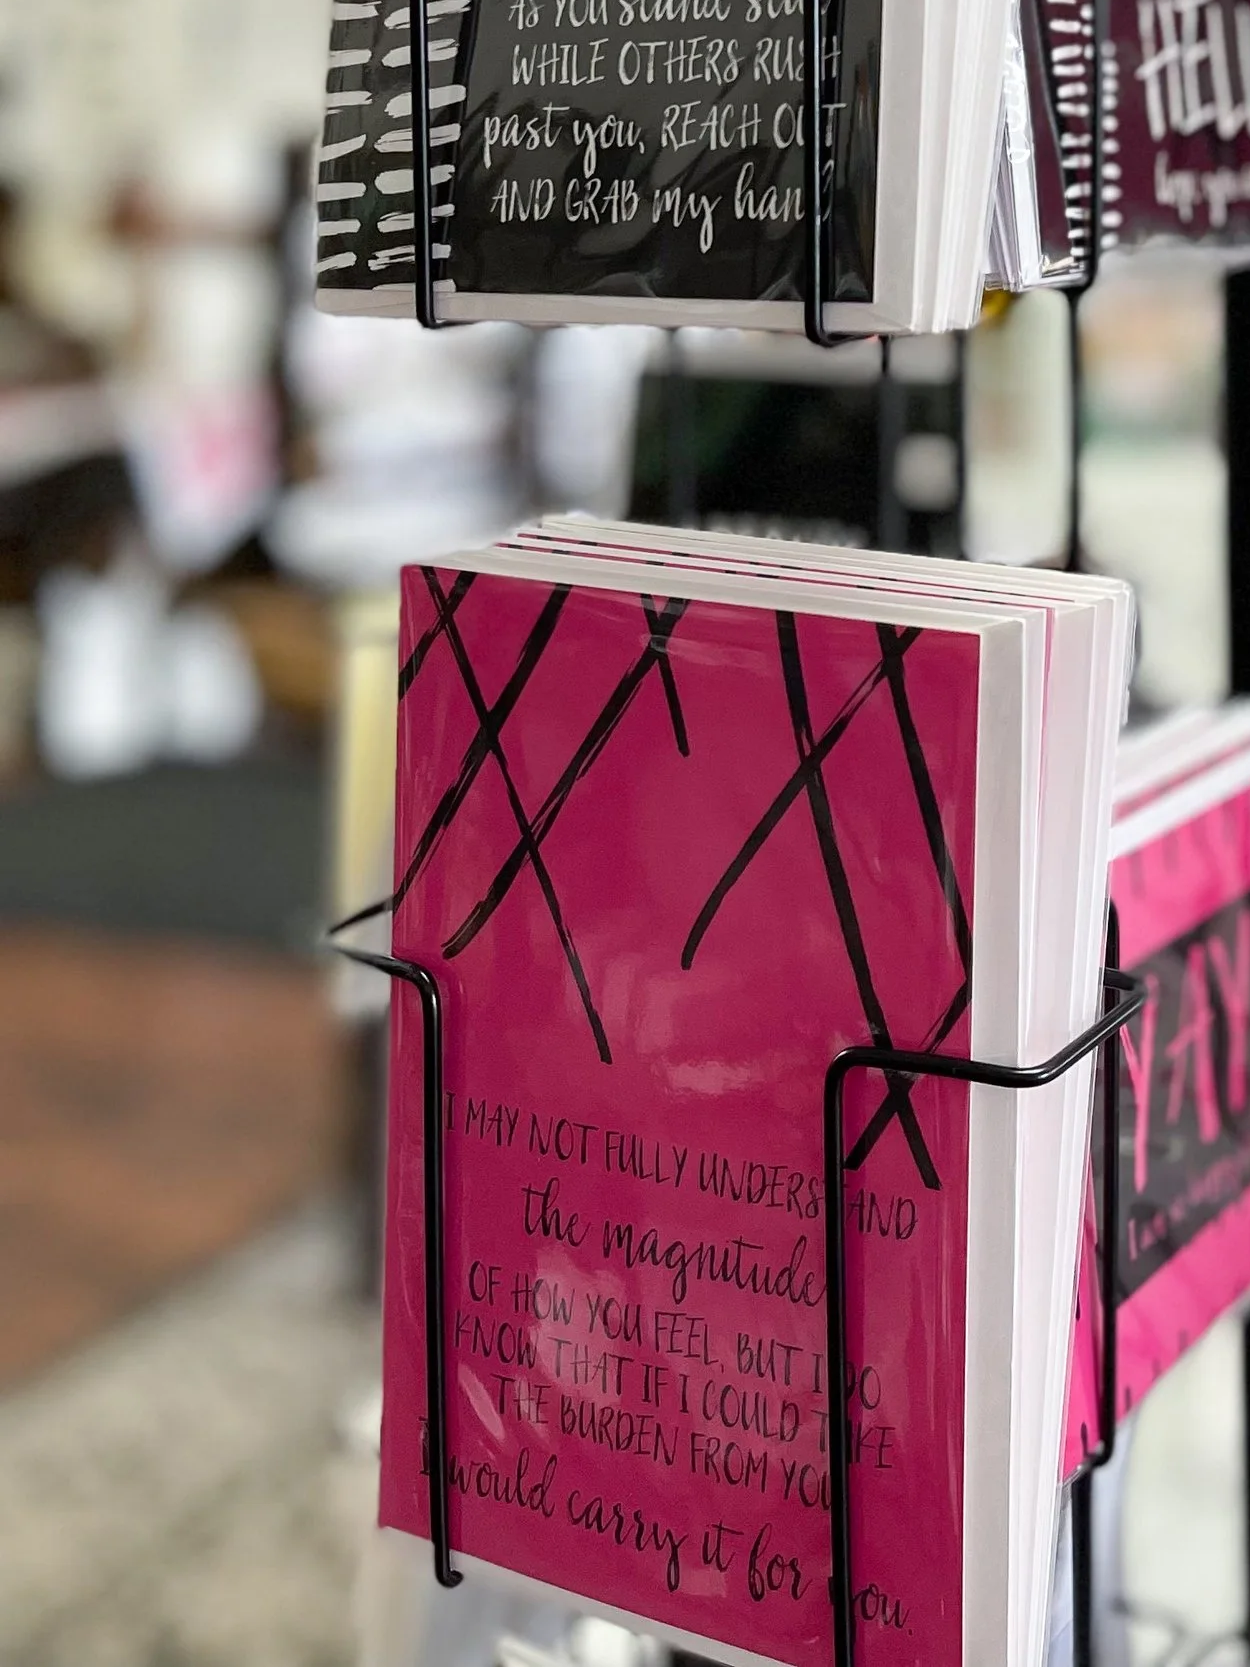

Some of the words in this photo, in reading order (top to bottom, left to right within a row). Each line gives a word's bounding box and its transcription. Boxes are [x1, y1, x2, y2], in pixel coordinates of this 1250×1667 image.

[511, 38, 609, 86] WHILE
[617, 35, 746, 85] OTHERS
[483, 101, 570, 170] past
[573, 113, 646, 178] you,
[660, 100, 762, 152] REACH
[489, 178, 556, 223] AND
[565, 178, 641, 224] GRAB
[651, 186, 722, 254] my
[446, 1091, 456, 1131] I
[466, 1098, 520, 1146] MAY
[529, 1112, 600, 1164] NOT
[606, 1131, 688, 1187] FULLY
[699, 1152, 918, 1239] UNDERSAND
[522, 1177, 591, 1247] the
[604, 1220, 828, 1307] magnitude
[455, 1310, 537, 1369] KNOW
[548, 1337, 634, 1396] THAT
[642, 1364, 669, 1407] IF
[679, 1374, 690, 1413] I
[703, 1380, 803, 1442] COULD
[469, 1261, 502, 1306] OF
[511, 1273, 575, 1325] HOW
[586, 1293, 642, 1347] YOU
[655, 1312, 724, 1373] FEEL,
[738, 1333, 803, 1385] BUT
[812, 1353, 824, 1394] I
[490, 1374, 551, 1424] THE
[560, 1394, 679, 1466] BURDEN
[691, 1432, 768, 1493] FROM
[450, 1447, 557, 1518] would
[568, 1490, 688, 1592] carry
[702, 1520, 744, 1572] it
[749, 1523, 813, 1601] for
